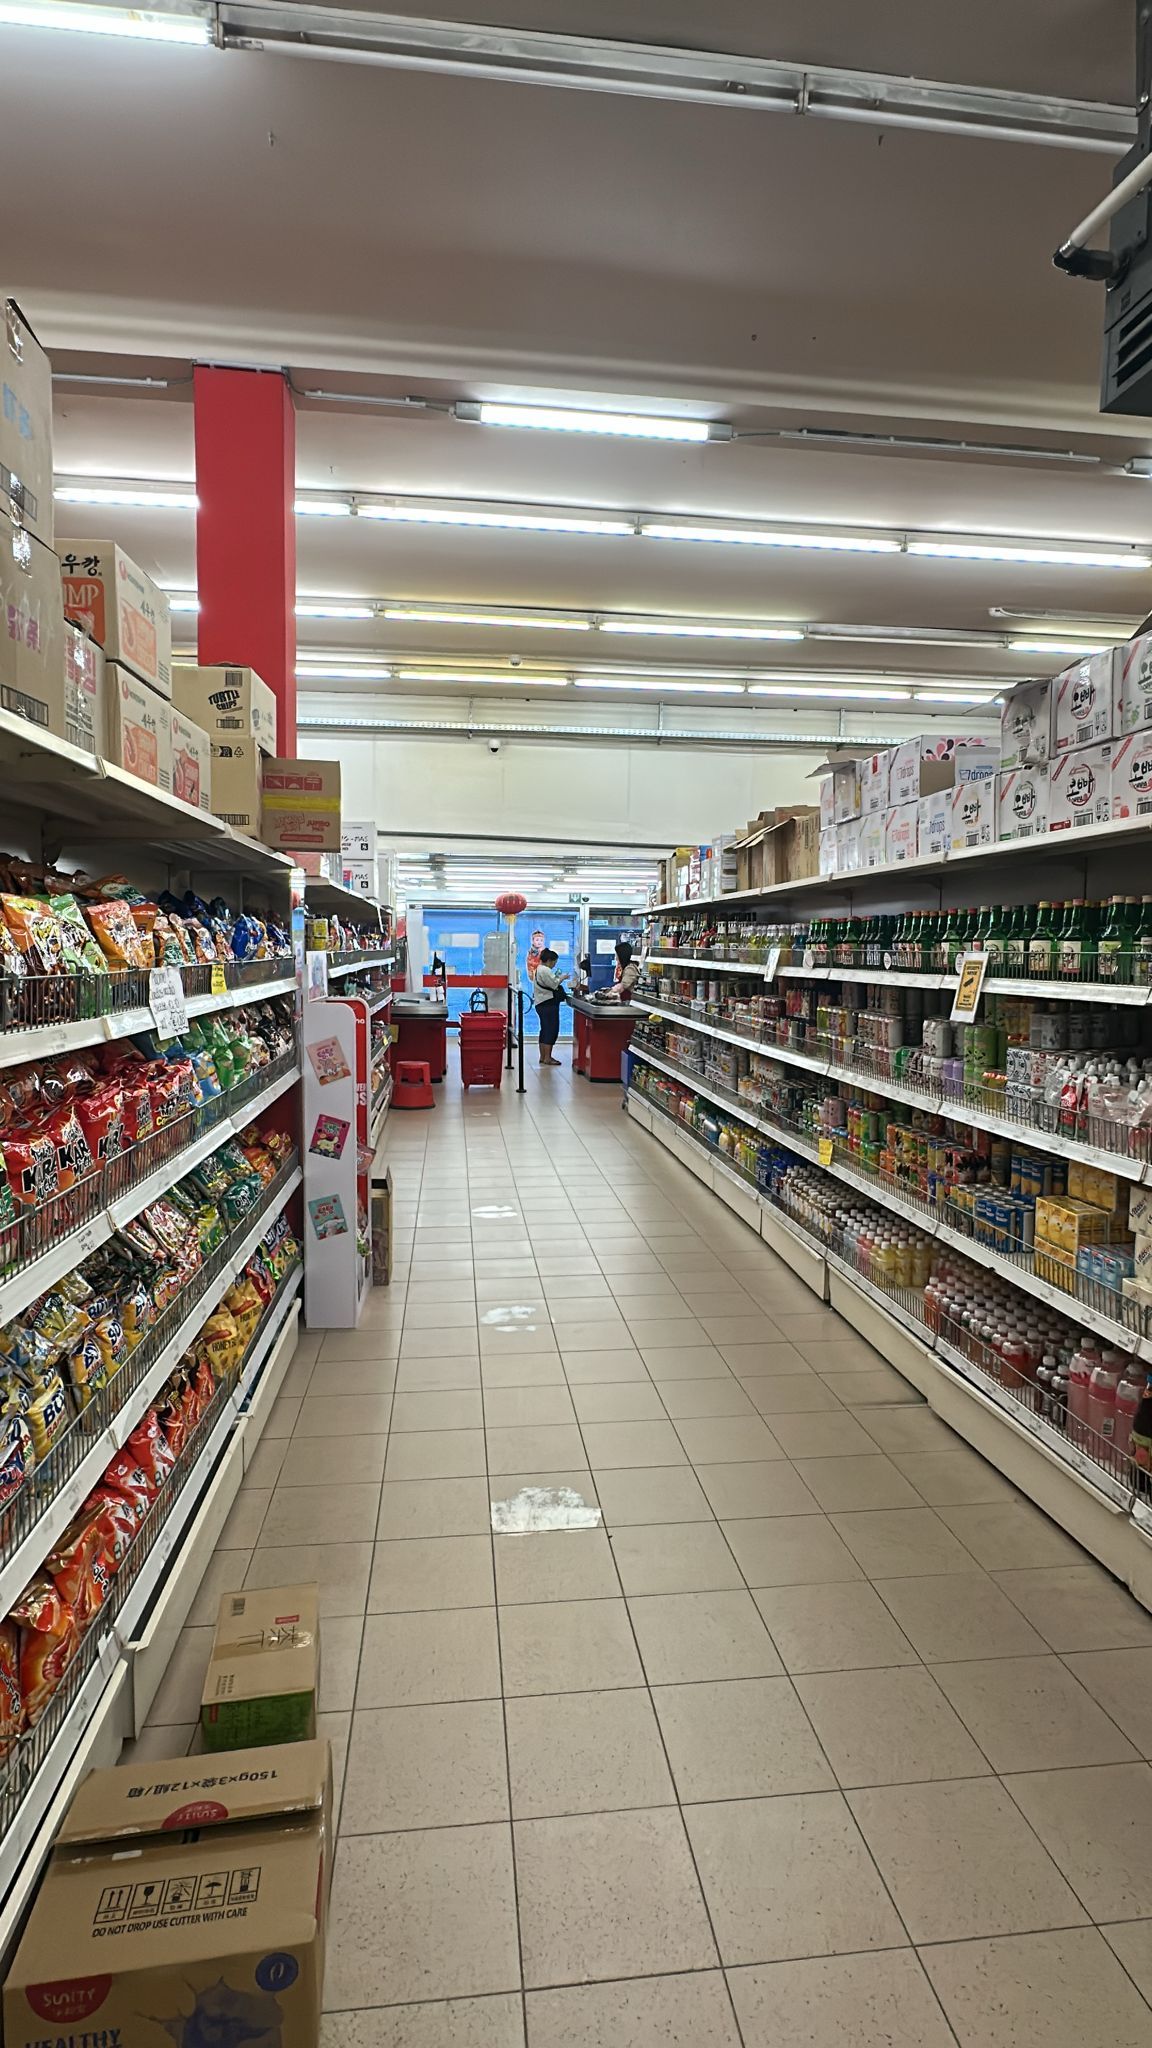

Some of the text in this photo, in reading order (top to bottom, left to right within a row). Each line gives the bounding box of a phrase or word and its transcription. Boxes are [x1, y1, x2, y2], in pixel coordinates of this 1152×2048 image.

[208, 689, 240, 704] TURTLE
[216, 700, 237, 711] CHIPS
[92, 1907, 248, 1938] DO NOT DROP USE CUTTER WITH CARE
